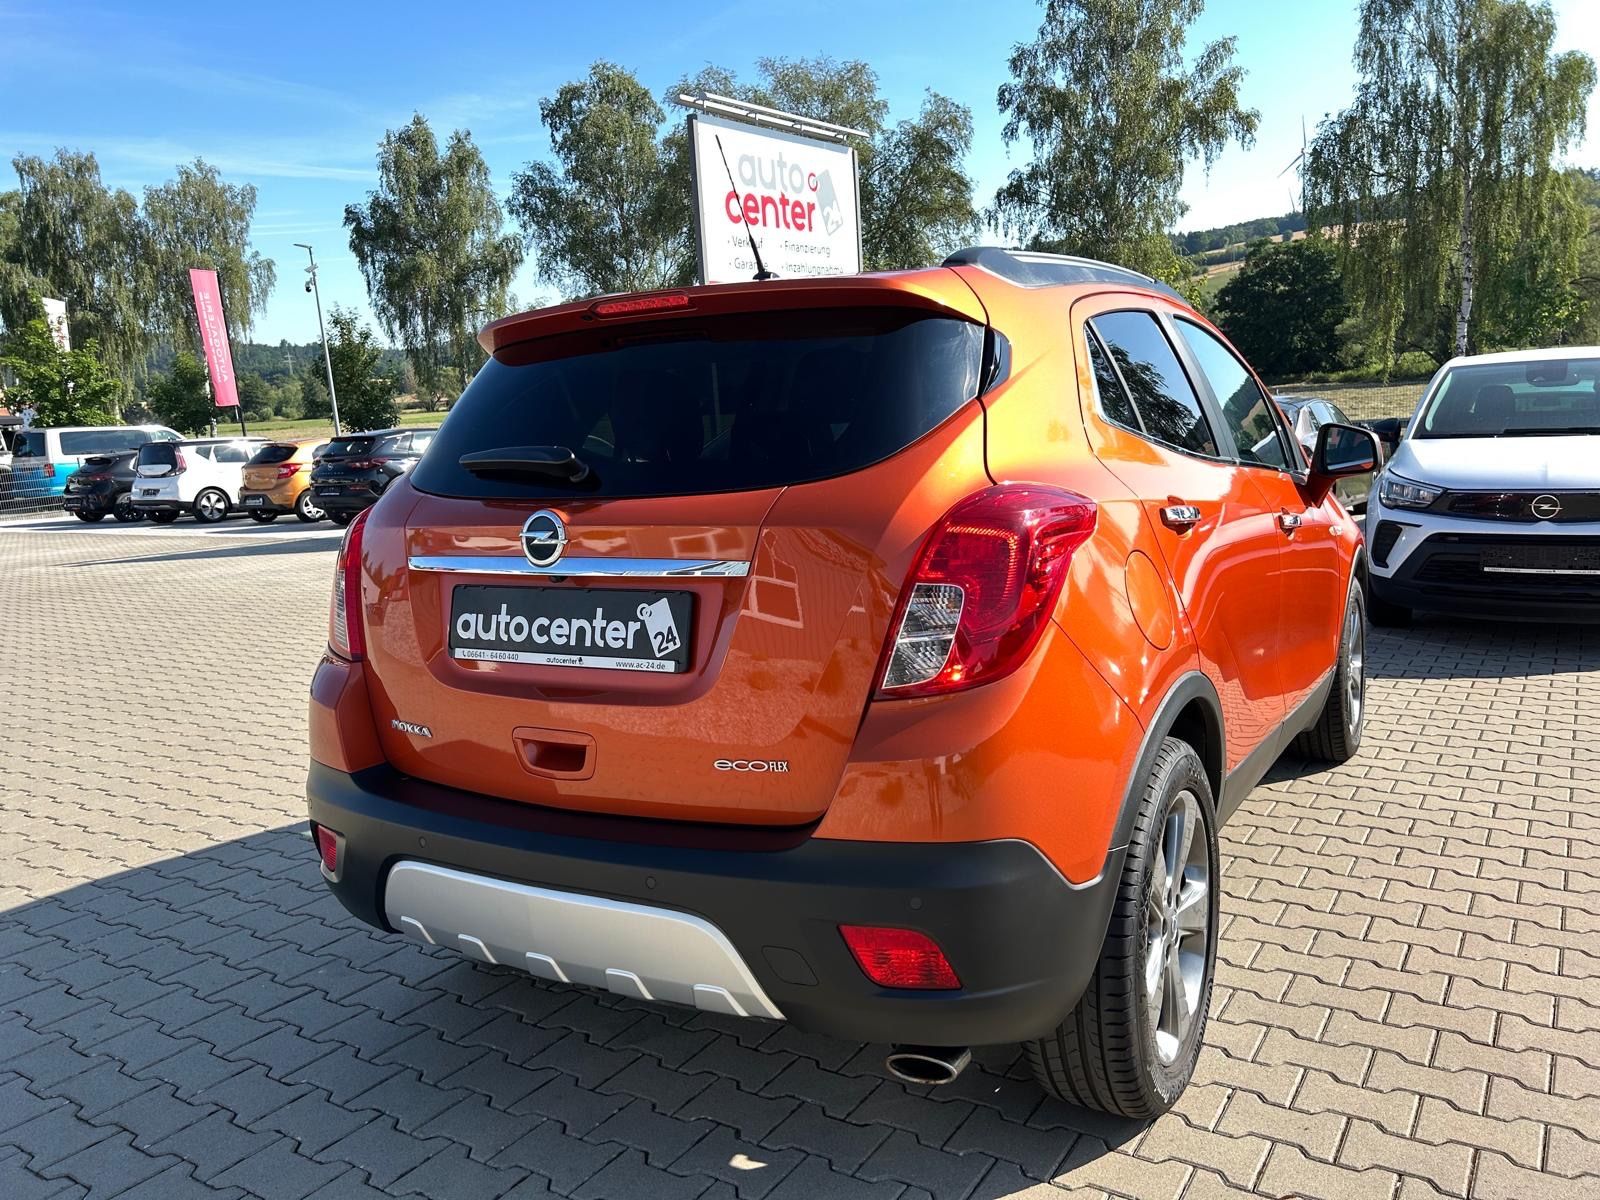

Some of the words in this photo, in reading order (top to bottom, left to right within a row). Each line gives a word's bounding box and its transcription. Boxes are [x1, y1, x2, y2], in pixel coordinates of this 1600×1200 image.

[738, 152, 804, 193] auto
[725, 190, 815, 232] center
[732, 235, 763, 249] Verkuf
[784, 240, 831, 258] Finanzierung
[653, 626, 677, 653] 24
[615, 660, 666, 671] www.ac-24.de
